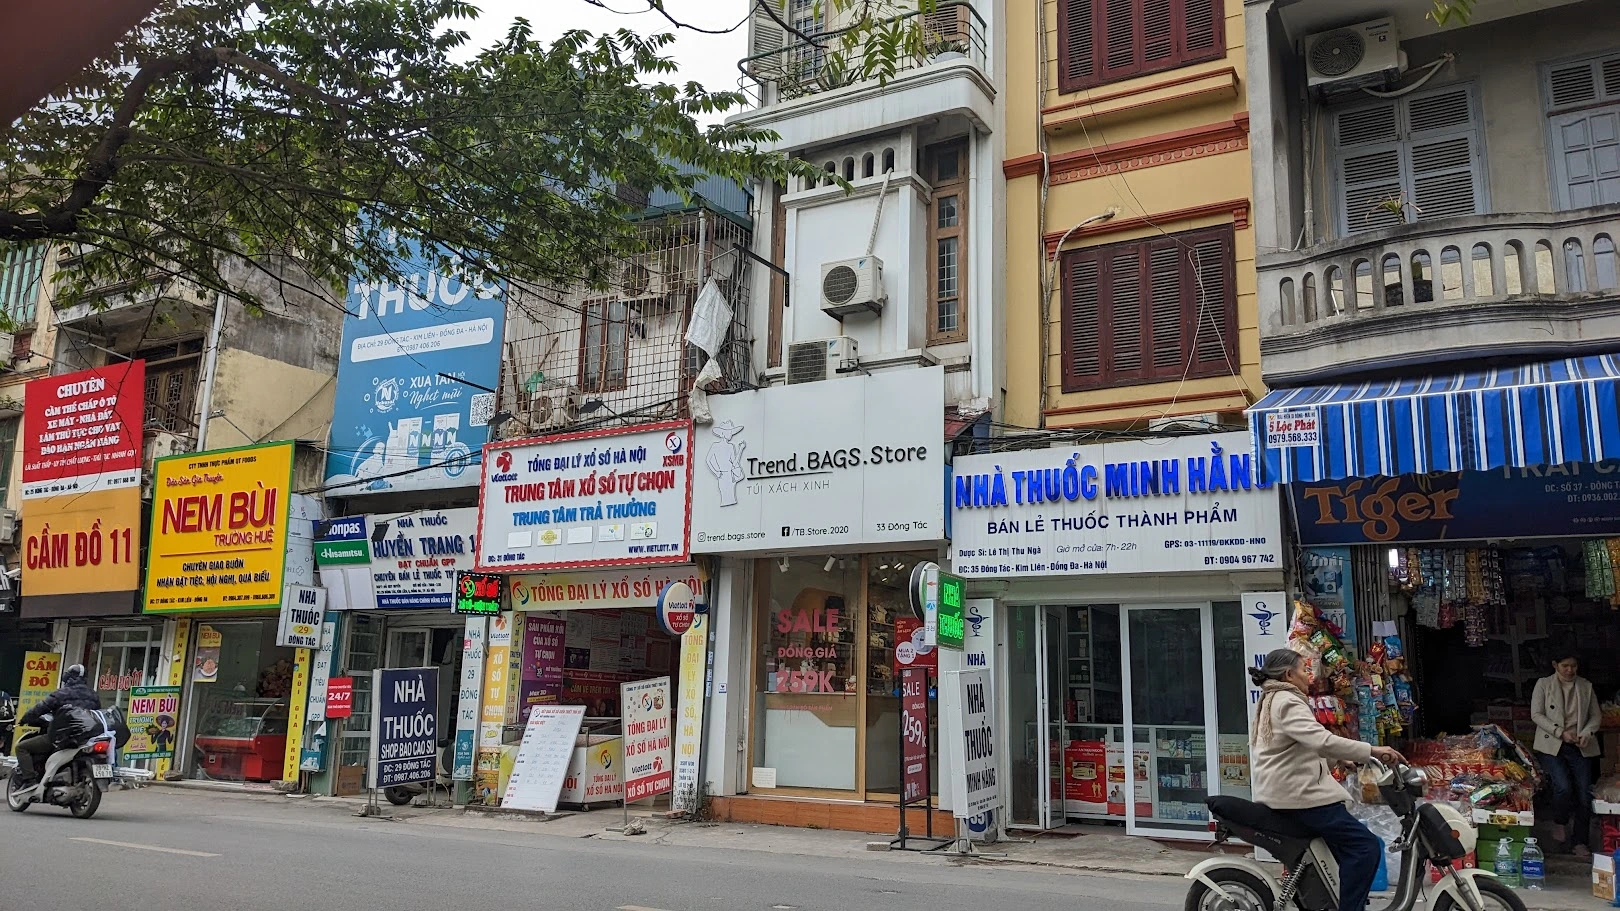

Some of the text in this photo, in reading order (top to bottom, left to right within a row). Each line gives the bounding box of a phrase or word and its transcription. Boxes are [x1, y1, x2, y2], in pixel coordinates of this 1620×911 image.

[57, 376, 105, 398] CHUYÊN
[410, 376, 432, 389] XUA
[409, 387, 440, 410] Nghẹt
[1269, 420, 1316, 434] 5 Lộc Phát
[1268, 432, 1318, 444] 0979.568.333
[528, 454, 552, 472] TỔNG
[554, 454, 570, 472] ĐẠI
[572, 452, 582, 468] LÝ
[584, 447, 596, 468] XỔ
[598, 446, 611, 465] SỐ
[614, 448, 626, 464] HÀ
[630, 446, 646, 464] NỘI
[662, 454, 684, 468] XSMB
[747, 446, 928, 476] Trend.BAGS.Store
[955, 441, 1273, 508] NHÀ THUỐC MINH HẰN
[504, 468, 676, 504] TRUNG TÂM XỔ SỐ TỰ CHỌN
[747, 478, 830, 496] TÚI XÁCH XINH
[1561, 482, 1572, 492] SỐ
[1568, 495, 1580, 503] ĐT:
[162, 481, 278, 534] NEM BÙI
[512, 497, 657, 526] TRUNG TÂM TRẢ THƯỞNG
[1304, 478, 1460, 542] Tiger
[397, 512, 448, 528] NHÀ THUỐC
[988, 502, 1237, 534] BÁN LẺ THUỐC THÀNH PHẨM
[27, 518, 132, 570] CẦM ĐỒ 11
[372, 531, 414, 558] HUYỀN
[420, 534, 465, 556] TRANG
[628, 543, 679, 554] WWW.VIETLOTT.VN
[999, 548, 1010, 556] Thị
[1012, 547, 1024, 555] Thu
[1164, 540, 1182, 548] GPS:
[182, 558, 245, 572] CHUYÊN GIAO BUÔN
[398, 556, 456, 570] ĐẠT CHUẨN GPP
[1204, 554, 1274, 564] ĐT: 0904 967 742
[374, 570, 396, 582] CHUYÊN
[399, 571, 410, 580] BÁN
[412, 569, 420, 580] LẺ
[422, 568, 442, 580] THUỐC
[958, 566, 970, 574] ĐC:
[999, 564, 1010, 572] Tác
[1016, 564, 1028, 572] Kim
[1030, 562, 1046, 572] Liên
[1070, 562, 1079, 570] Đa
[156, 576, 174, 588] NHẬN
[175, 575, 188, 588] ĐẶT
[206, 574, 217, 586] HỘI
[238, 572, 252, 584] QUÀ
[254, 570, 270, 582] BIẾU
[531, 574, 651, 603] TỔNG ĐẠI LÝ XỔ SỐ
[299, 589, 317, 605] NHÀ
[291, 606, 320, 626] THUỐC
[777, 608, 839, 634] SALE
[298, 626, 308, 634] 29
[468, 627, 480, 639] NHÀ
[464, 648, 482, 660] THUỐC
[493, 650, 503, 664] XỔ
[778, 642, 838, 658] ĐỒNG GIÁ
[26, 656, 58, 672] CẦM
[967, 651, 986, 666] NHÀ
[28, 672, 50, 687] ĐỒ
[468, 670, 474, 680] 29
[492, 668, 502, 682] SỐ
[776, 670, 835, 694] 259K
[328, 692, 350, 701] 24/7
[394, 674, 426, 703] NHÀ
[490, 688, 500, 700] TỰ
[903, 682, 920, 697] SALE
[967, 676, 986, 714] NHÀ
[132, 694, 176, 714] NEM BÙI
[484, 705, 504, 718] CHỌN
[462, 708, 474, 720] TÁC
[384, 708, 434, 740] THUỐC
[628, 716, 667, 736] TỔNG ĐẠI LÝ
[903, 710, 926, 748] 259k
[626, 736, 670, 757] XỔ SỐ HÀ NỘI
[965, 716, 993, 762] THUỐC
[381, 740, 434, 760] SHOP BAO CAO SU
[384, 764, 394, 773] ĐC:
[394, 763, 402, 772] 29
[420, 758, 432, 768] TÁC
[632, 763, 652, 774] Vietlott
[384, 770, 430, 783] ĐT: 0987.406.206
[967, 772, 980, 794] MINH
[628, 778, 670, 798] XỔ SỐ TỰ CHỌN
